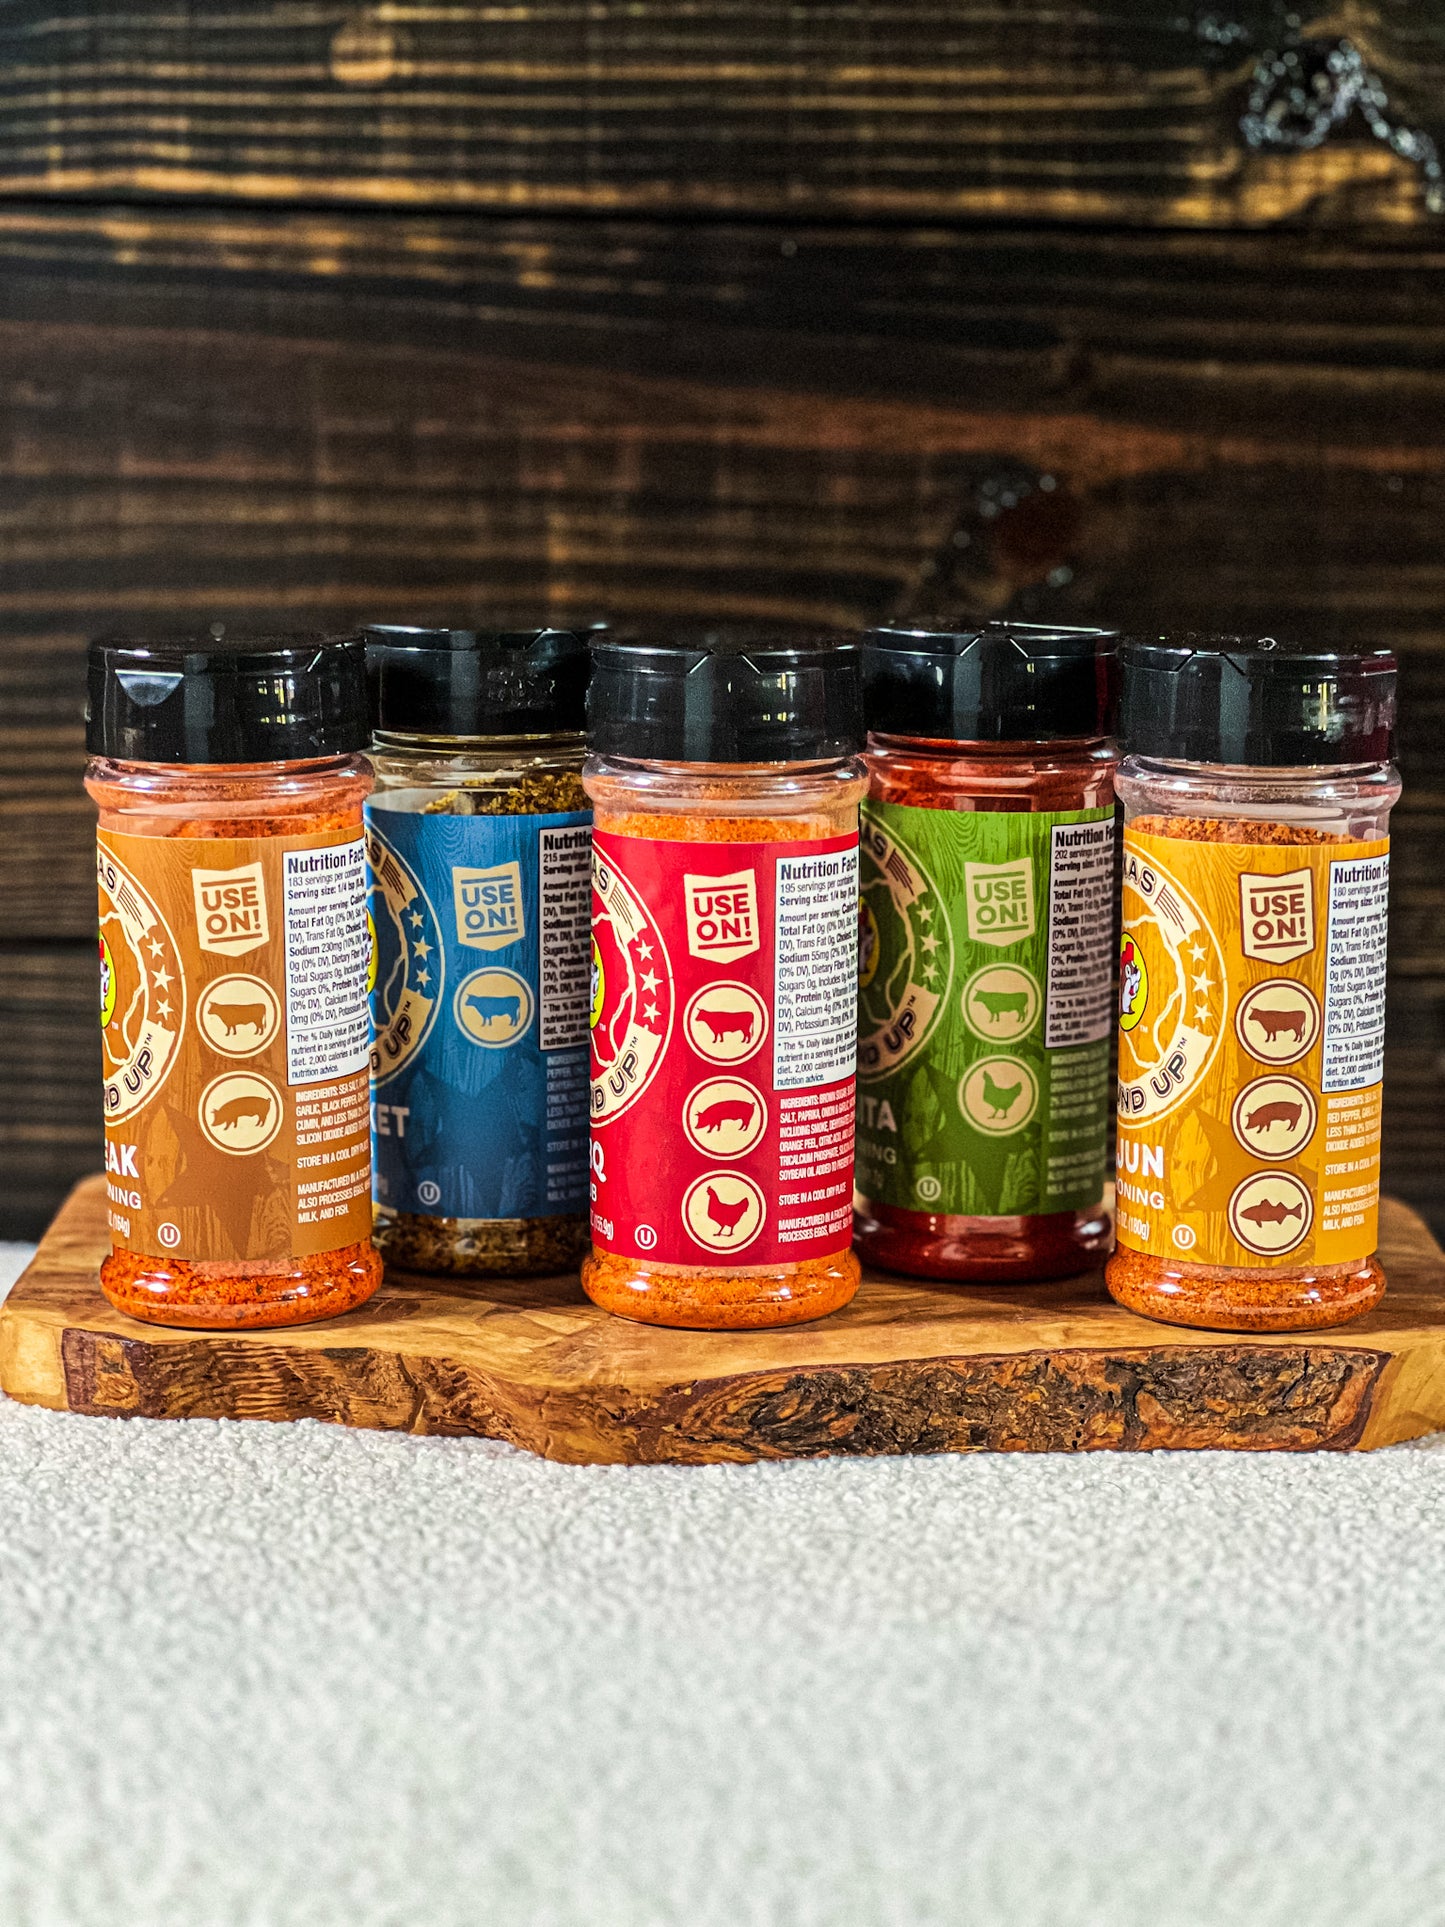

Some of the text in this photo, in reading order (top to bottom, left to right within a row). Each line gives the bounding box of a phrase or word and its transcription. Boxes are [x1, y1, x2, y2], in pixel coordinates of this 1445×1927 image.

[1056, 829, 1103, 847] Nutrition
[544, 853, 557, 863] 215
[1055, 850, 1067, 859] 202
[288, 854, 346, 873] Nutrition
[1055, 861, 1080, 872] Serving
[781, 861, 838, 880] Nutrition
[1335, 864, 1380, 884] Nutrition
[289, 877, 303, 886] 183
[305, 874, 333, 884] servings
[781, 883, 795, 893] 195
[797, 881, 825, 892] servings
[974, 880, 1028, 903] USE
[1348, 885, 1371, 896] servings
[201, 885, 258, 911] USE
[288, 888, 318, 899] Serving
[462, 885, 515, 908] USE
[1054, 890, 1071, 900] Total
[694, 893, 750, 918] USE
[780, 896, 810, 906] Serving
[1251, 892, 1305, 918] USE
[1333, 898, 1358, 909] Serving
[289, 906, 327, 916] Amount per
[977, 903, 1028, 926] ON!
[206, 908, 262, 934] ON!
[289, 916, 333, 929] Total Fat 0g
[465, 906, 516, 929] ON!
[780, 913, 818, 922] Amount per
[1332, 916, 1365, 925] Amount per
[696, 917, 752, 941] ON!
[779, 925, 800, 936] Total
[803, 924, 814, 934] Fat
[1253, 916, 1307, 941] ON!
[1332, 929, 1361, 939] Total Fat
[306, 929, 335, 941] Trans Fat
[797, 937, 826, 948] Trans Fat
[1346, 942, 1361, 952] Trans
[289, 942, 342, 957] Sodium 230mg
[779, 951, 829, 963] Sodium 55mg
[1330, 956, 1356, 966] Sodium
[290, 971, 332, 983] Total Sugars
[779, 981, 805, 992] Sugars
[1330, 982, 1366, 993] Total Sugars
[290, 987, 316, 998] Sugars
[796, 991, 821, 1003] Protein
[1329, 997, 1351, 1008] Sugars
[796, 1007, 822, 1017] Calcium
[796, 1019, 829, 1030] Potassium
[297, 1035, 308, 1043] The
[291, 1044, 316, 1055] nutrient
[784, 1042, 795, 1050] The
[1332, 1044, 1343, 1052] The
[310, 1055, 326, 1065] 2,000
[777, 1053, 802, 1063] nutrient
[1326, 1055, 1348, 1065] nutrient
[292, 1068, 318, 1078] nutrition
[795, 1063, 812, 1073] 2,000
[777, 1077, 804, 1086] nutrition
[1325, 1079, 1349, 1088] nutrition
[297, 1156, 321, 1168] STORE
[1325, 1162, 1347, 1175] STORE
[298, 1197, 317, 1210] ALSO
[779, 1194, 800, 1206] STORE
[320, 1207, 334, 1220] AND
[1324, 1204, 1340, 1216] ALSO
